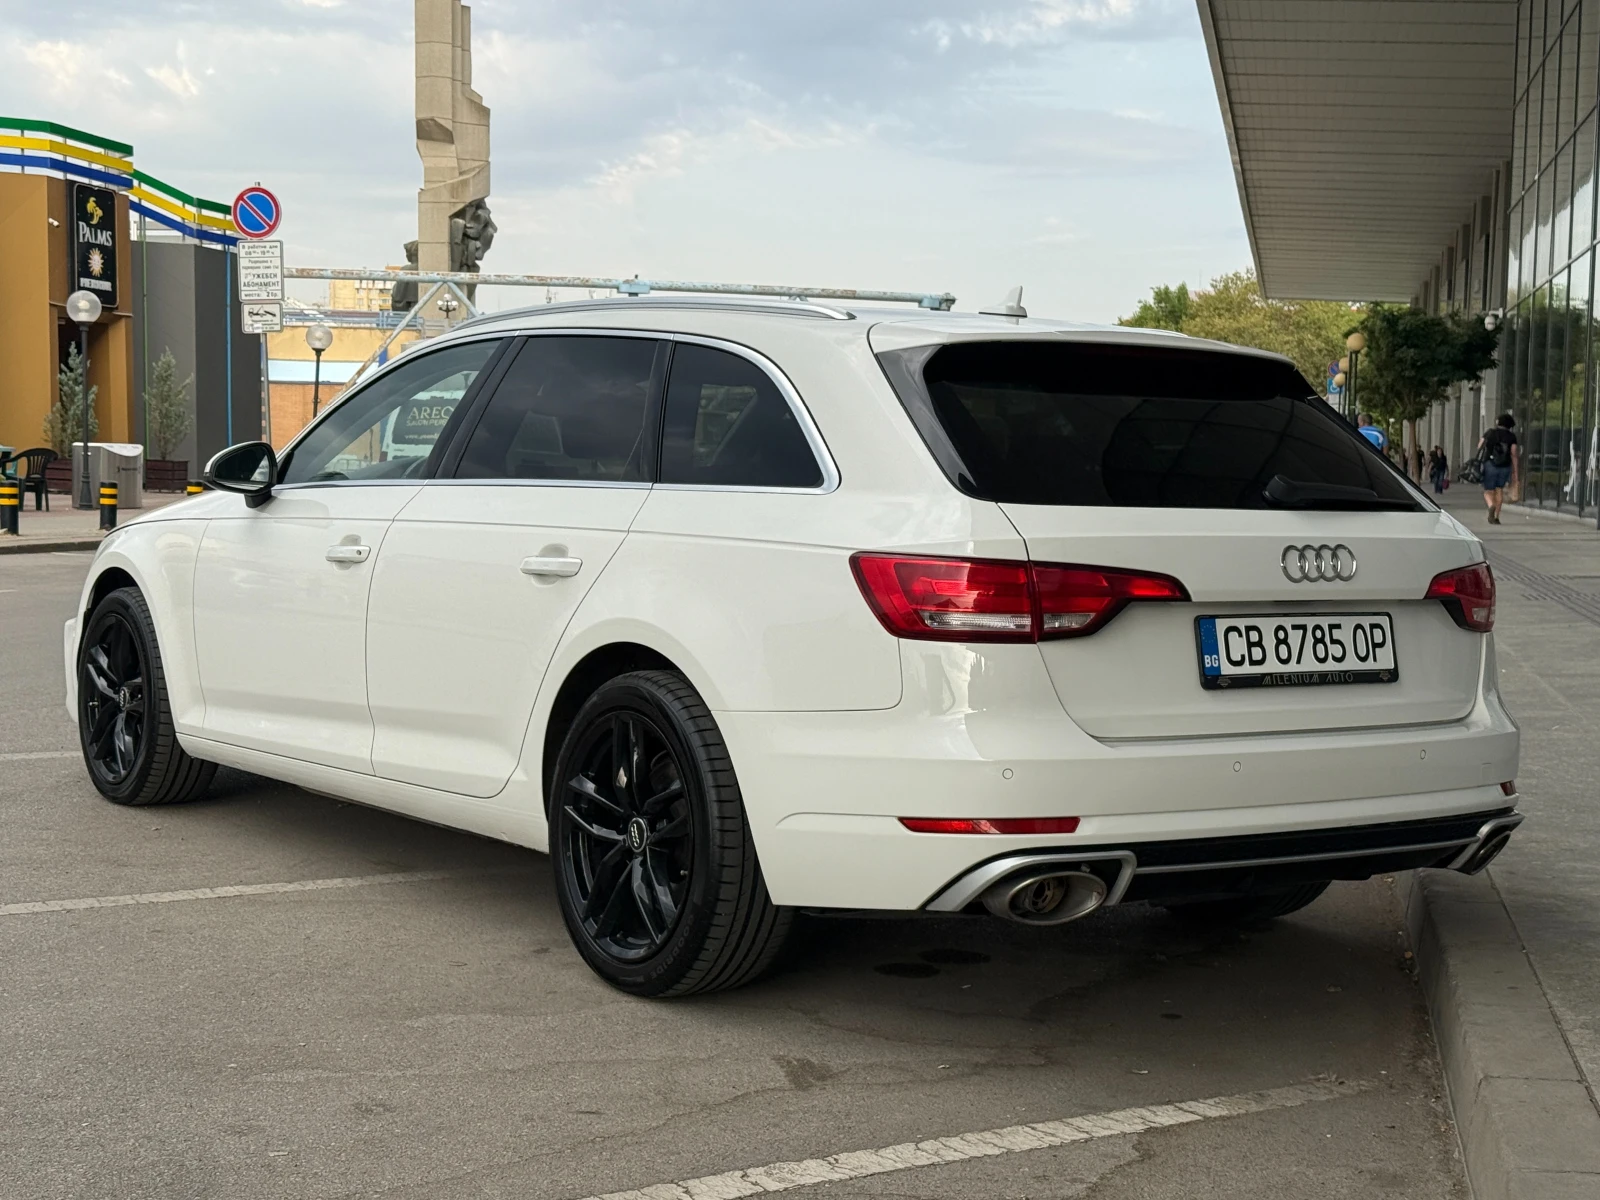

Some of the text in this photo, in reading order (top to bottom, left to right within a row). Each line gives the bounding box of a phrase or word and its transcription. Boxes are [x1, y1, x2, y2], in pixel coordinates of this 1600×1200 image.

[78, 221, 112, 246] PALMS
[1223, 625, 1267, 667] CB
[1273, 623, 1347, 665] 8785
[1204, 654, 1219, 668] BG
[1262, 672, 1354, 685] MILENIUM AUTO
